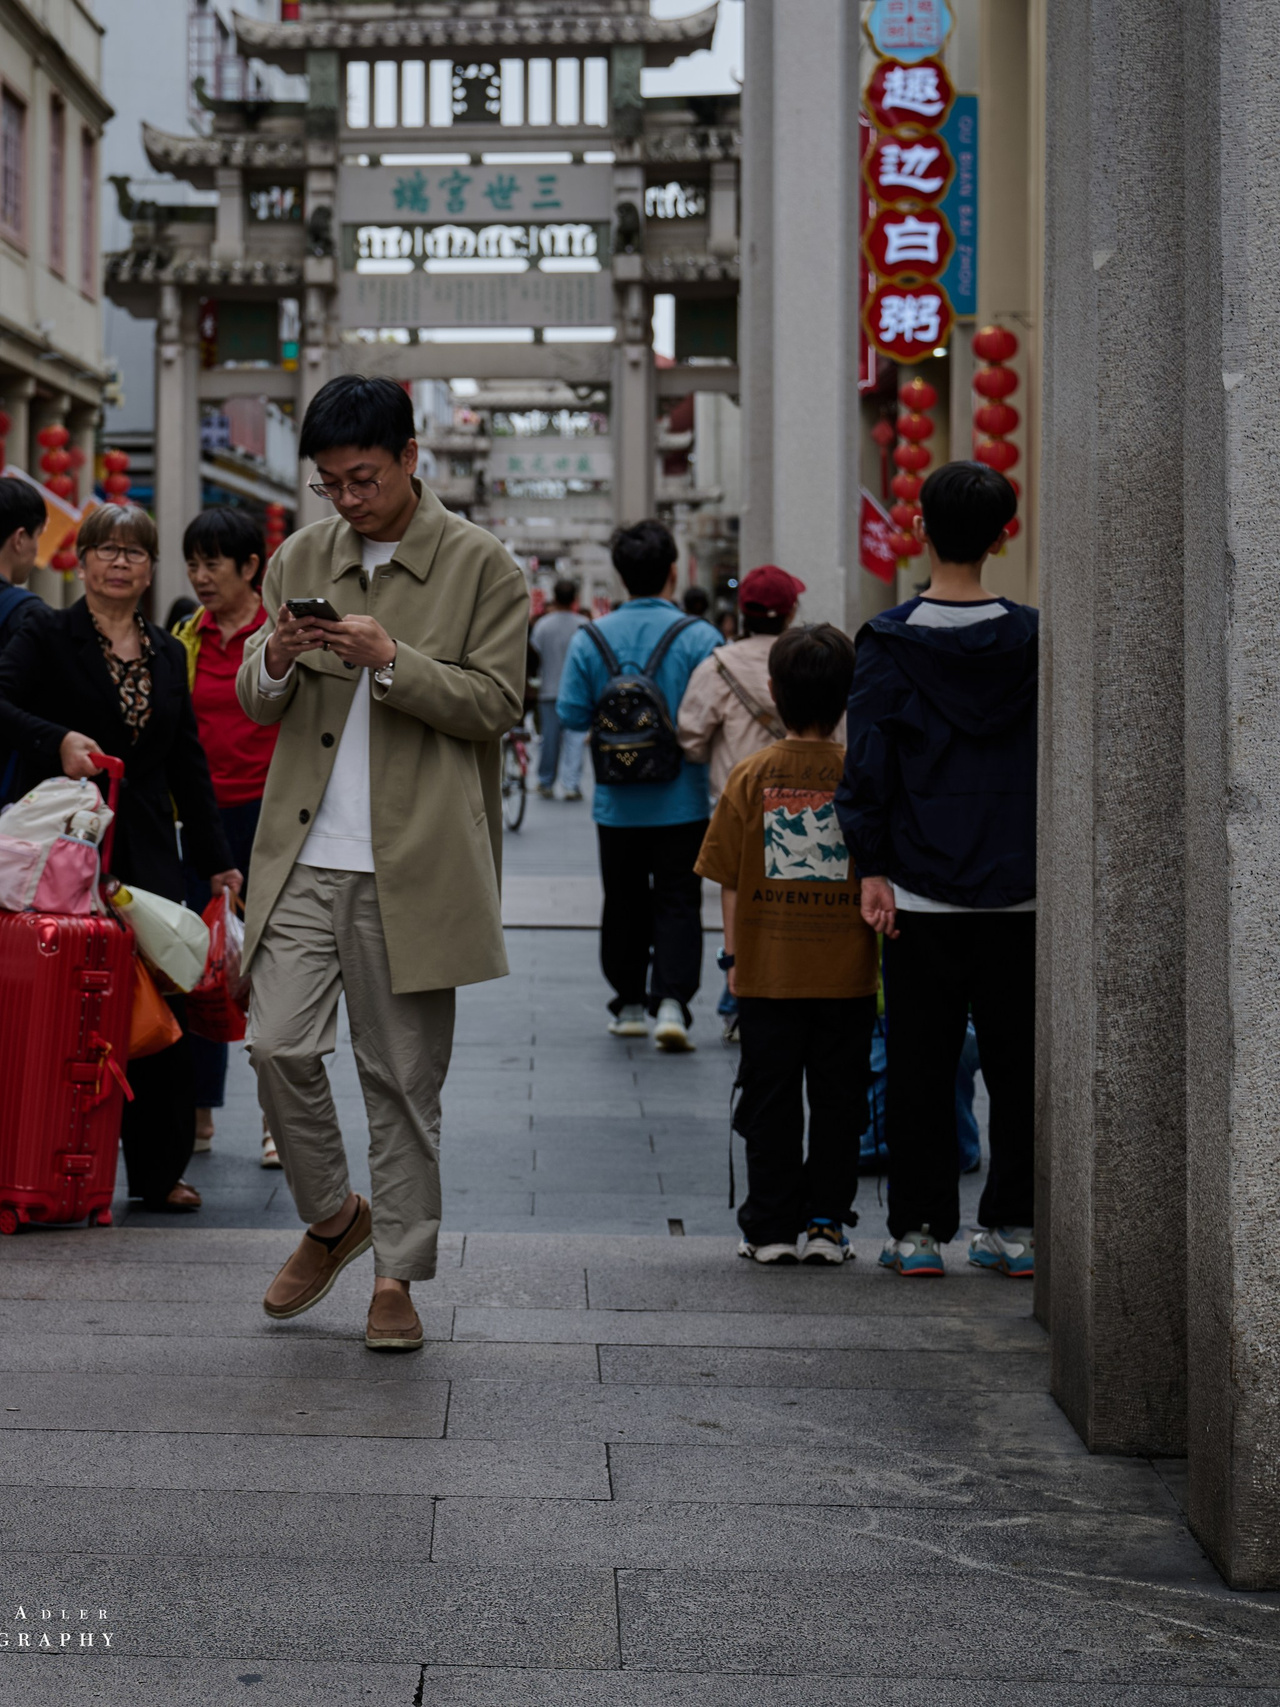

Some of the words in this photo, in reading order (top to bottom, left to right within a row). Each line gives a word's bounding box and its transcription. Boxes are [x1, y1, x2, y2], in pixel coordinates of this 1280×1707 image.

[878, 66, 945, 343] 趣边白粥
[752, 889, 860, 906] ADVENTURE
